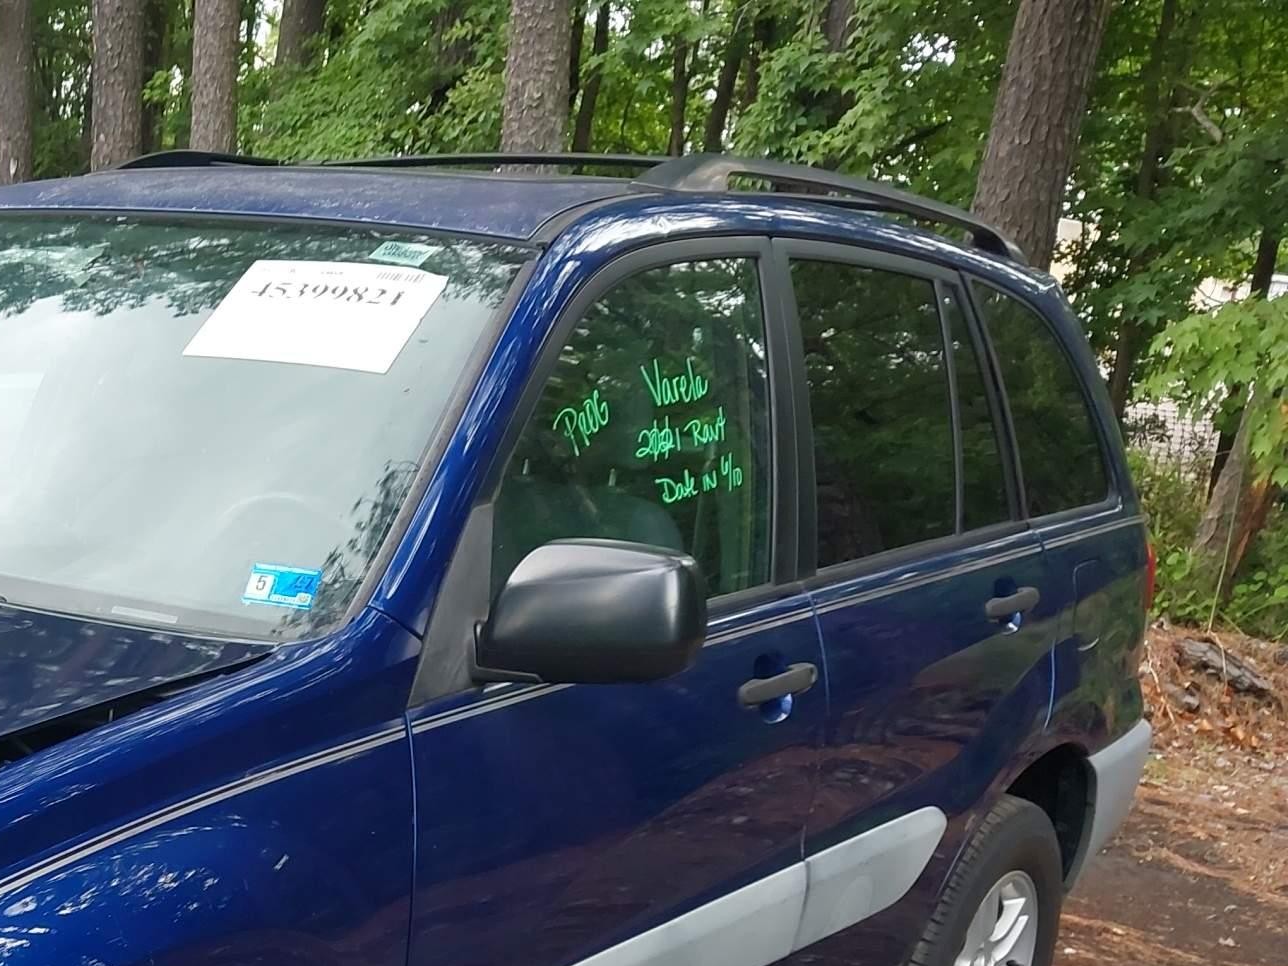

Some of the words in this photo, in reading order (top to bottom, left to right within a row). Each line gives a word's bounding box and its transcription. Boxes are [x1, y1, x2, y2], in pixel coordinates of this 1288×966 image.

[250, 281, 406, 306] 45399821
[640, 357, 709, 407] Varela
[654, 469, 700, 503] Date
[255, 575, 268, 591] 5
